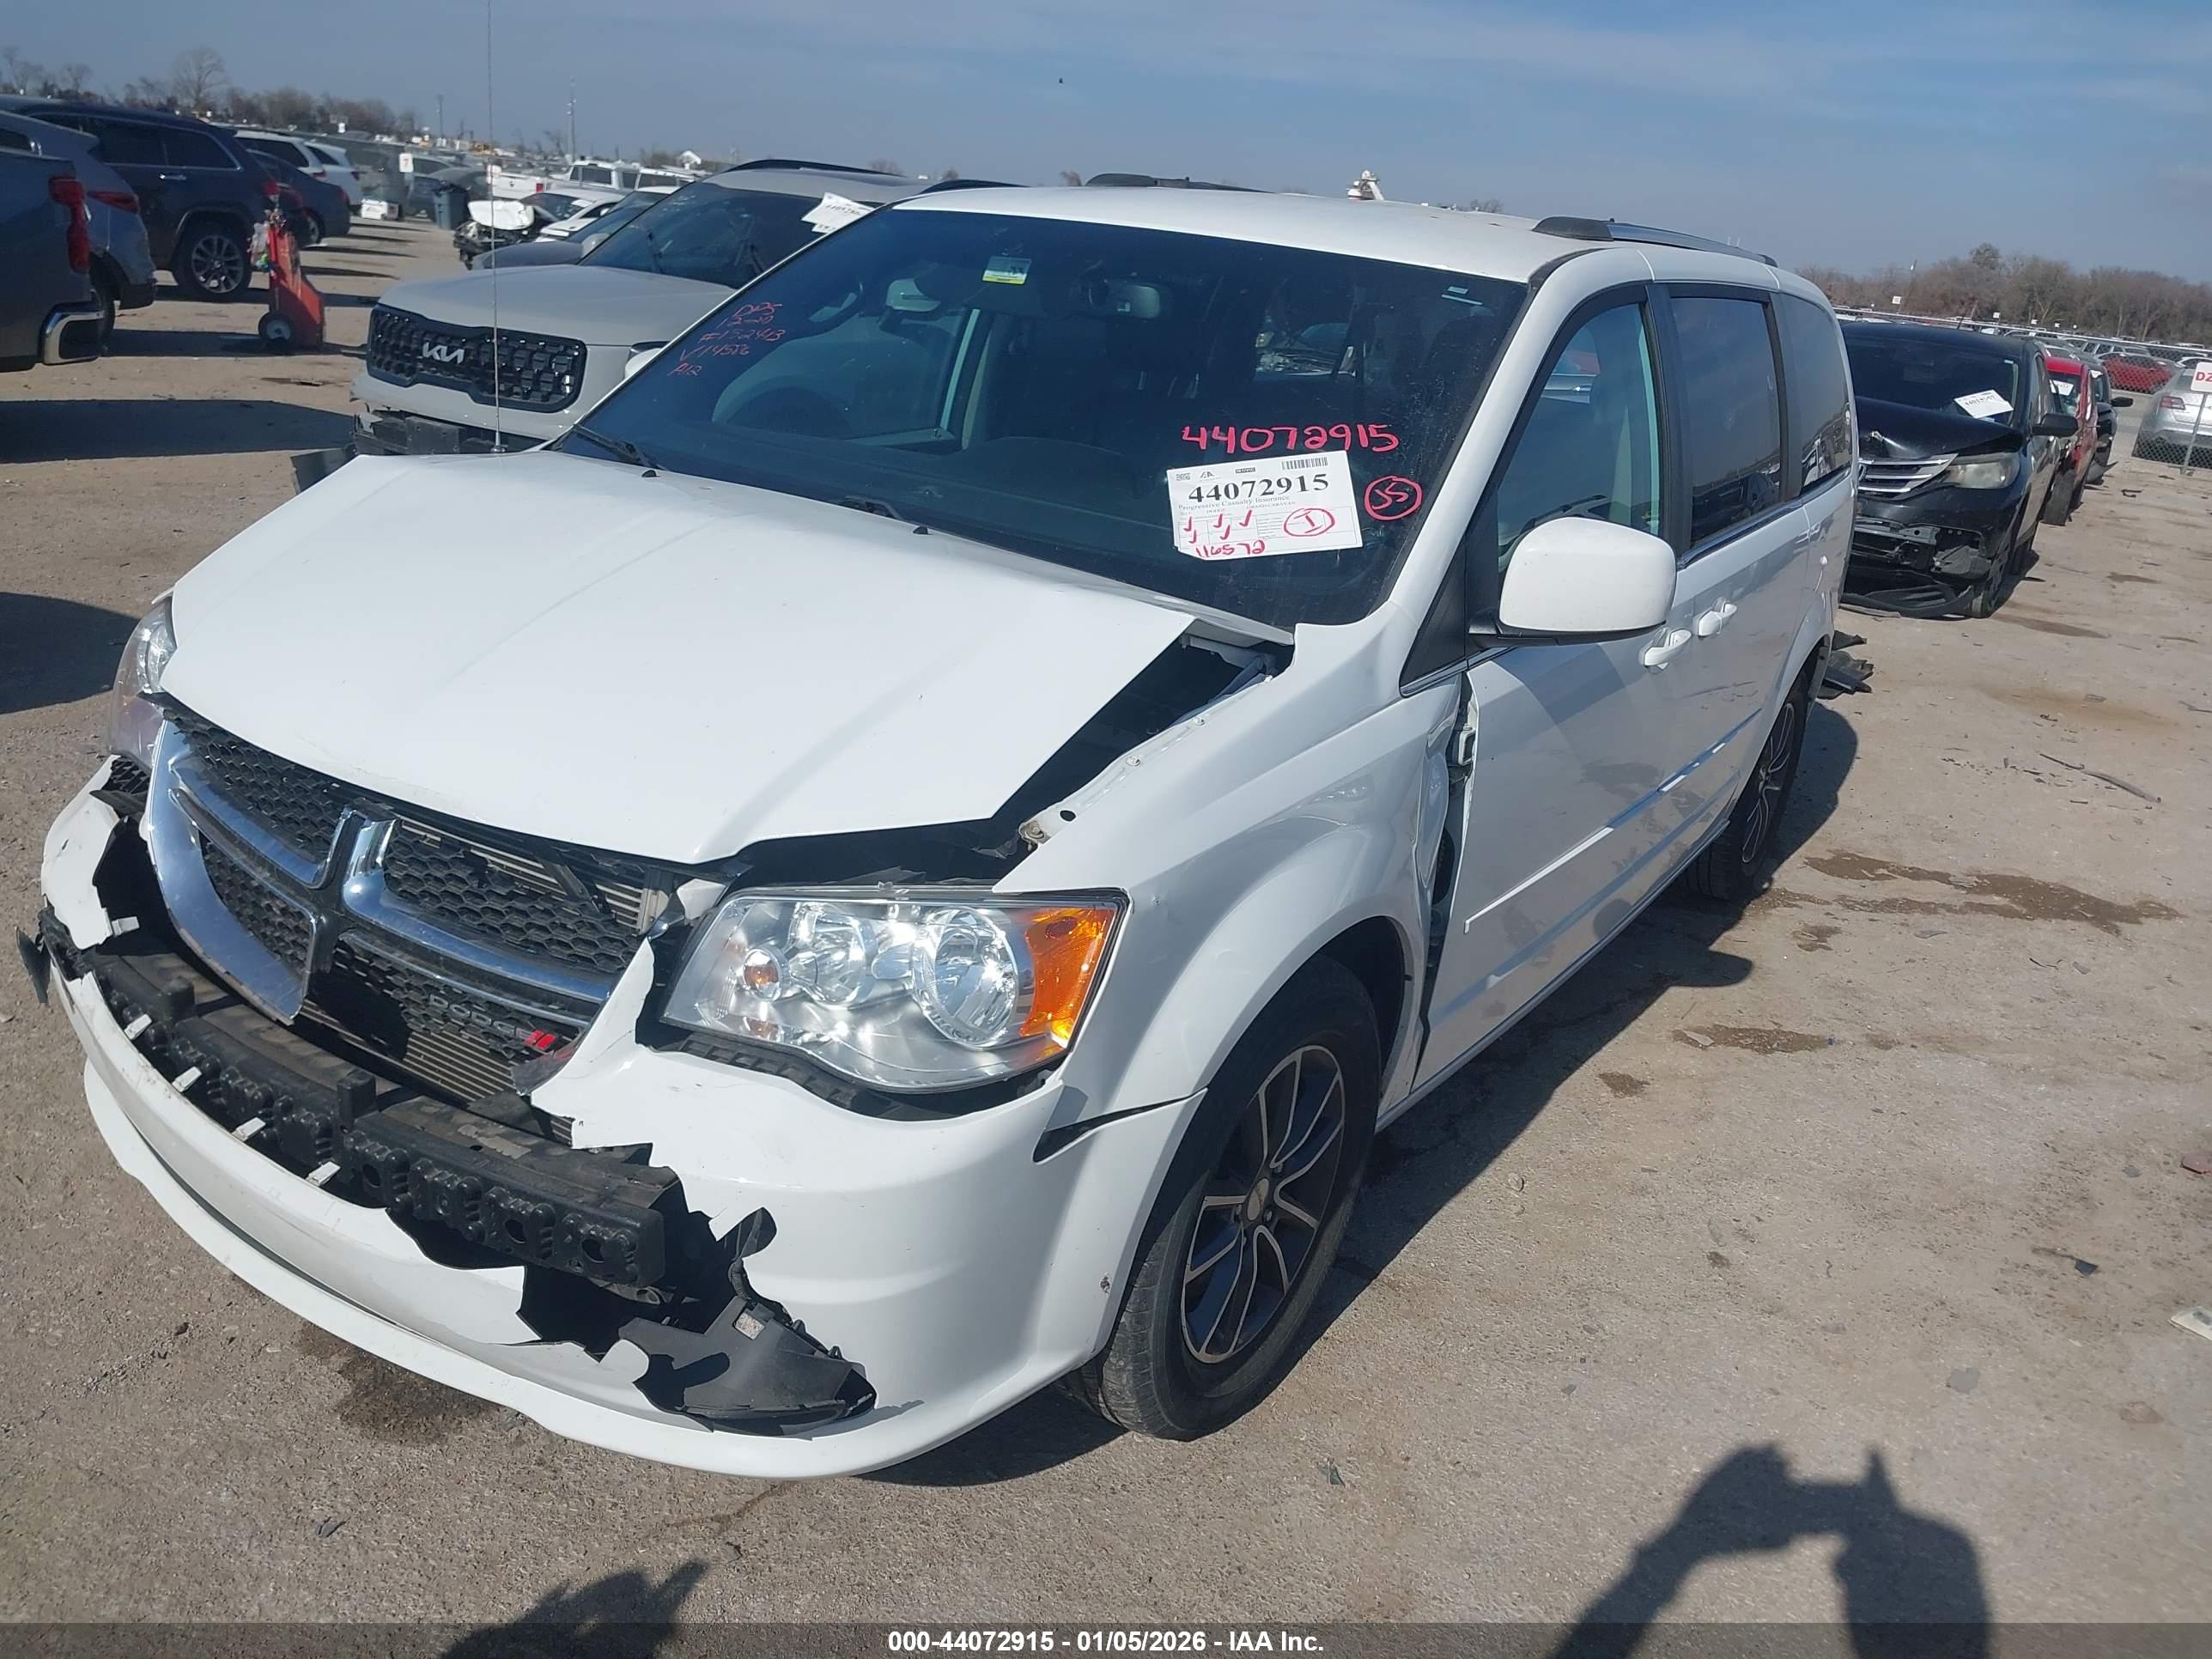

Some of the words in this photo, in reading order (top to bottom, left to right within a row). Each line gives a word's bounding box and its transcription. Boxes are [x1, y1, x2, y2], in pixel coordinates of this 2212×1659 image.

[1182, 424, 1399, 453] 44072915
[1188, 473, 1328, 502] 44072915
[429, 994, 534, 1041] DODGE
